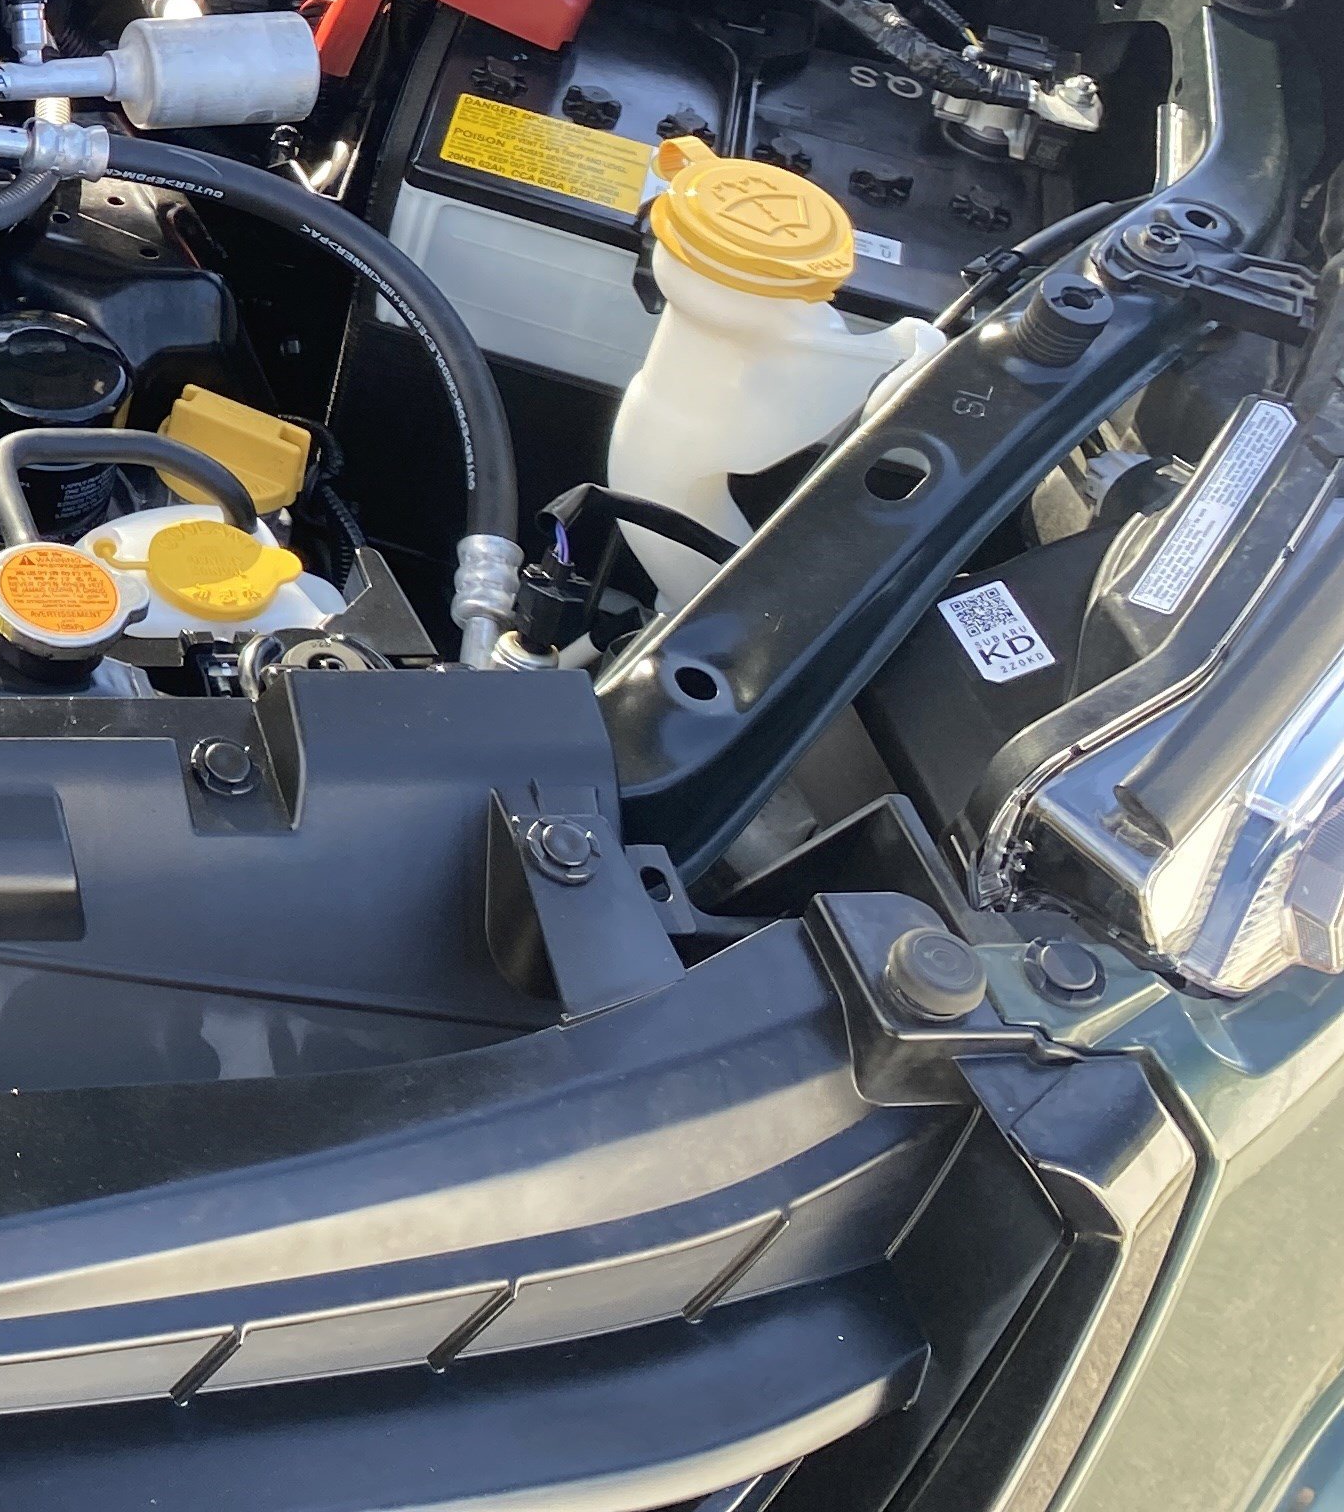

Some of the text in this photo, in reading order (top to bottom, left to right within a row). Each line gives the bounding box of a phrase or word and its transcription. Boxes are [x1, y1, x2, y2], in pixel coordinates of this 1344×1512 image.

[463, 96, 518, 117] DANGER
[453, 127, 506, 147] POISON
[974, 625, 1028, 650] SUBARU
[979, 635, 1035, 666] KD
